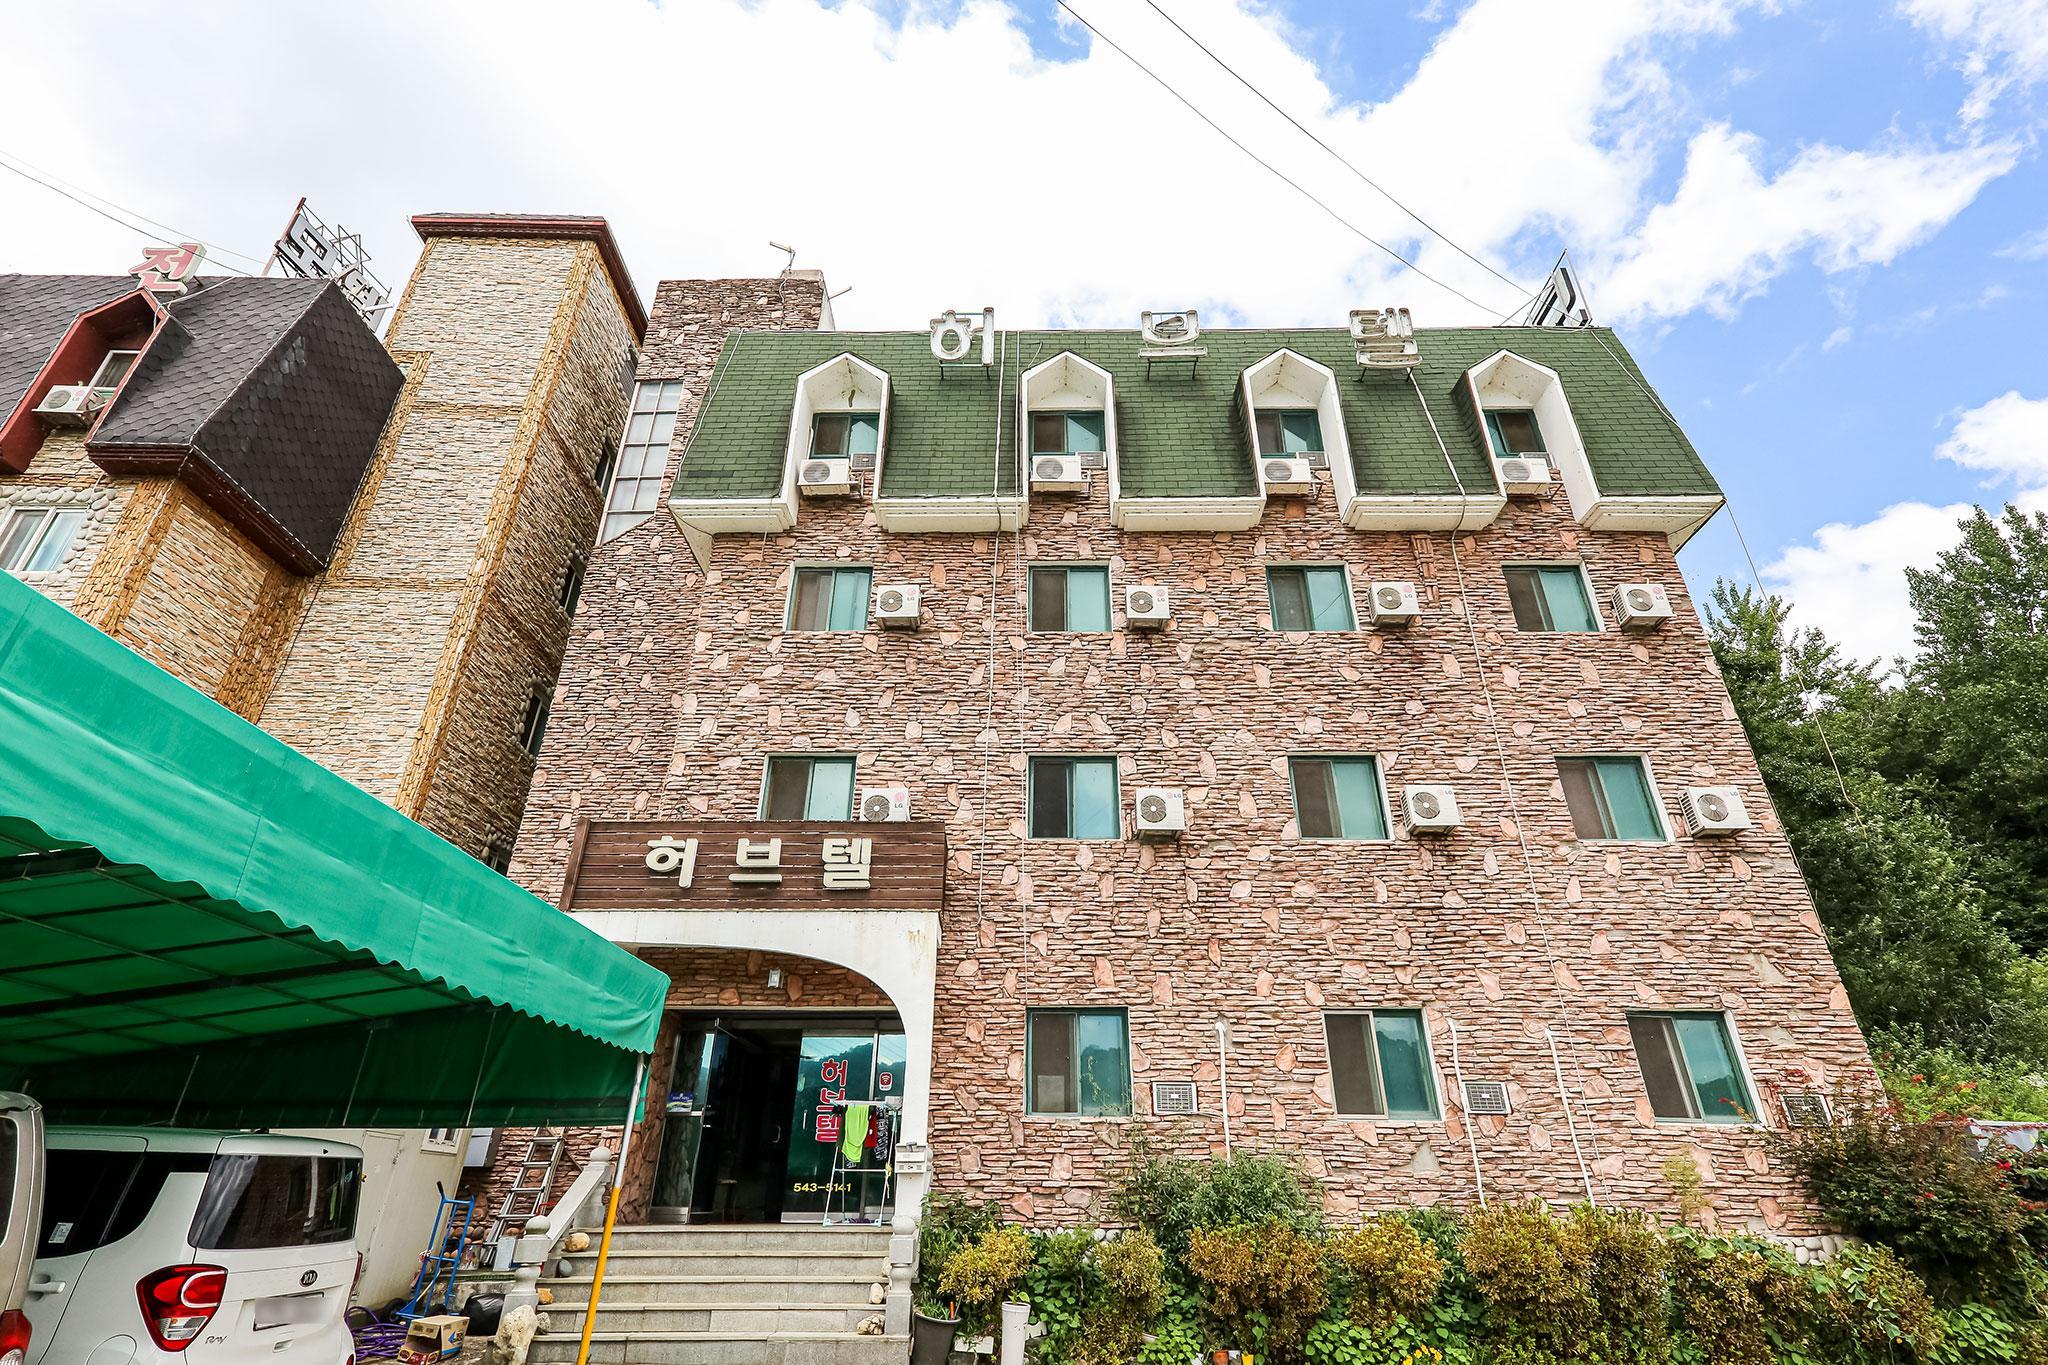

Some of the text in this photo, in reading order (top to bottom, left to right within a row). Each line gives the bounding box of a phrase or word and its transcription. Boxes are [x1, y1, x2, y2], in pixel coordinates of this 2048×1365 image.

[129, 242, 206, 295] 전
[646, 836, 872, 888] 허브텔
[793, 1182, 852, 1192] 543-5141
[302, 1270, 317, 1285] KIA
